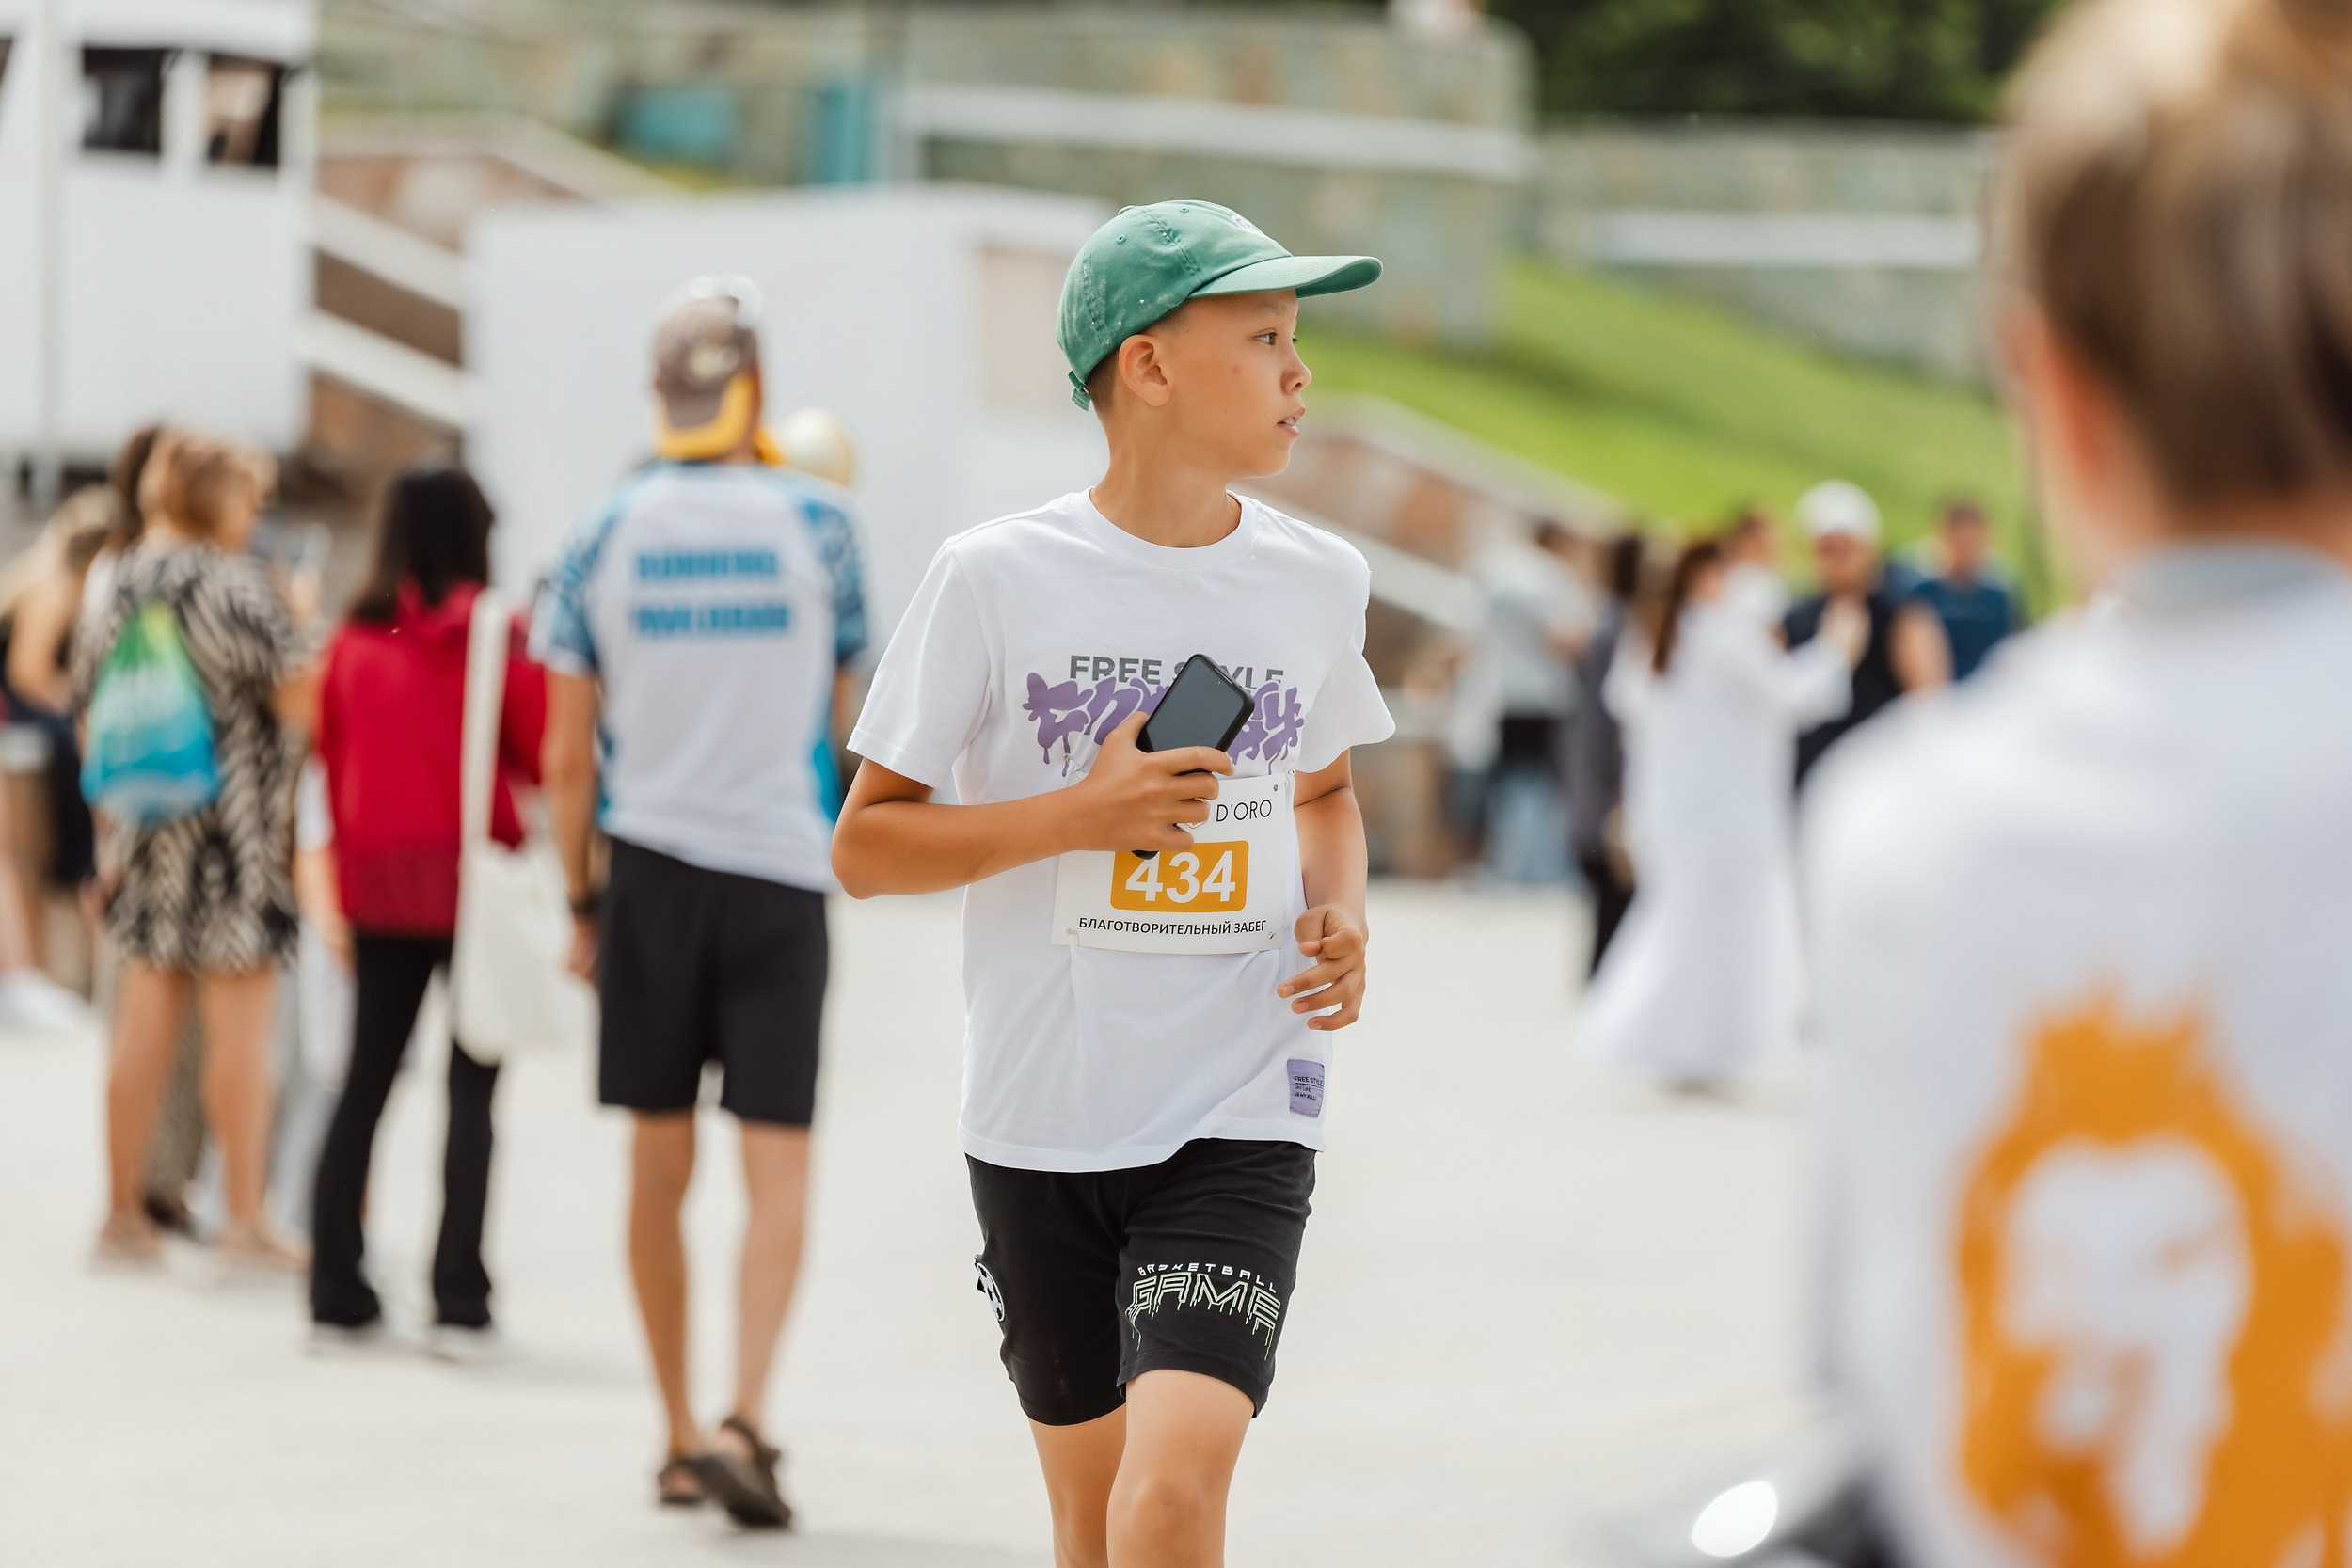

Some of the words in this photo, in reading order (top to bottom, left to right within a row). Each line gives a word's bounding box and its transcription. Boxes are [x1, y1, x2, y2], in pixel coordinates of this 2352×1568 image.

[1069, 655, 1163, 686] FREE
[1173, 661, 1284, 690] YLE
[1125, 849, 1236, 904] 434
[1078, 917, 1232, 935] БЛАГОТВОРИТЕЛЬНЫЙ
[1232, 919, 1267, 935] ЗАБЕГ
[1137, 1262, 1277, 1293] BASKETBALL
[1125, 1271, 1281, 1347] GAME
